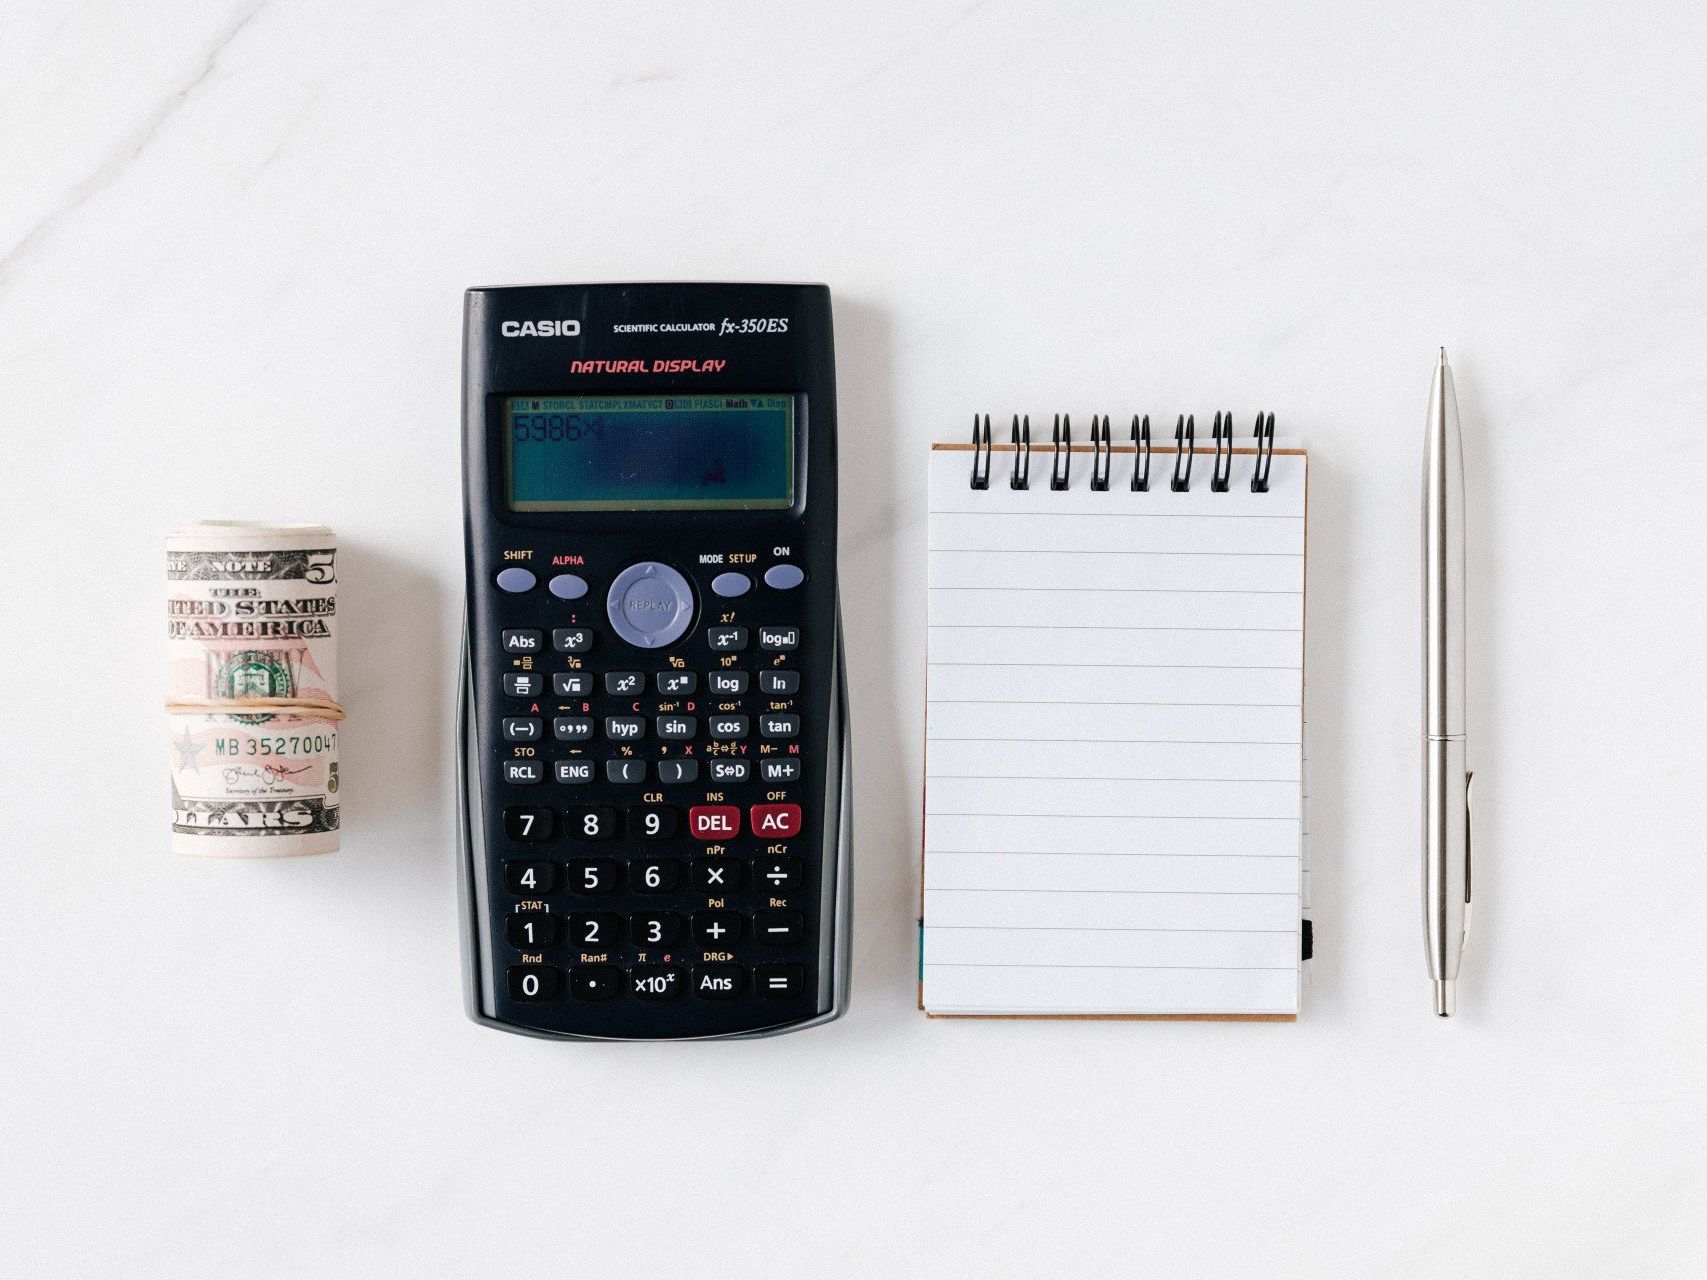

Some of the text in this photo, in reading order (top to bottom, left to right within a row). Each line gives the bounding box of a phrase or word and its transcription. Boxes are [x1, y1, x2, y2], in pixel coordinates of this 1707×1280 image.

[501, 319, 581, 337] CASIO
[613, 317, 789, 336] SCIENTIFIC CALCULATOR fx-350ES
[570, 359, 726, 374] NATURAL DISPLAY
[725, 398, 748, 408] Math
[503, 550, 534, 560] SHIFT
[773, 546, 790, 556] ON
[552, 555, 585, 565] ALPHA
[699, 554, 724, 564] MODE
[211, 560, 273, 573] NOTE
[304, 554, 336, 585] 5
[209, 588, 262, 599] THE
[168, 596, 336, 618] ITED STATES
[629, 600, 672, 611] REPLAY
[189, 618, 332, 639] AMERICA
[508, 635, 536, 648] Abs
[717, 676, 739, 692] log
[772, 676, 786, 690] ln
[530, 702, 540, 713] A
[582, 702, 590, 712] B
[632, 701, 640, 712] C
[687, 701, 696, 711] D
[611, 720, 639, 737] hyp
[665, 719, 687, 734] sin
[717, 721, 741, 733] cos
[767, 721, 792, 733] tan
[214, 733, 337, 756] MB 35270047
[789, 744, 799, 754] M
[514, 747, 535, 757] STO
[509, 766, 536, 779] RCL
[560, 765, 589, 778] ENG
[767, 764, 795, 778] M+
[643, 792, 663, 802] CLR
[706, 792, 724, 802] INS
[766, 791, 787, 801] OFF
[519, 814, 535, 836] 7
[583, 814, 599, 836] 8
[644, 813, 660, 835] 9
[697, 815, 732, 832] DEL
[761, 812, 789, 830] AC
[706, 845, 725, 855] nPr
[767, 844, 788, 854] nCr
[519, 867, 537, 889] 4
[584, 867, 599, 889] 5
[644, 866, 661, 888] 6
[520, 901, 543, 910] STAT
[708, 897, 725, 908] Pol
[769, 897, 787, 908] Rec
[523, 922, 534, 944] 1
[584, 921, 599, 943] 2
[647, 920, 662, 943] 3
[522, 953, 543, 963] Rnd
[580, 953, 608, 963] Ran#
[522, 974, 539, 996] 0
[699, 974, 733, 990] Ans
